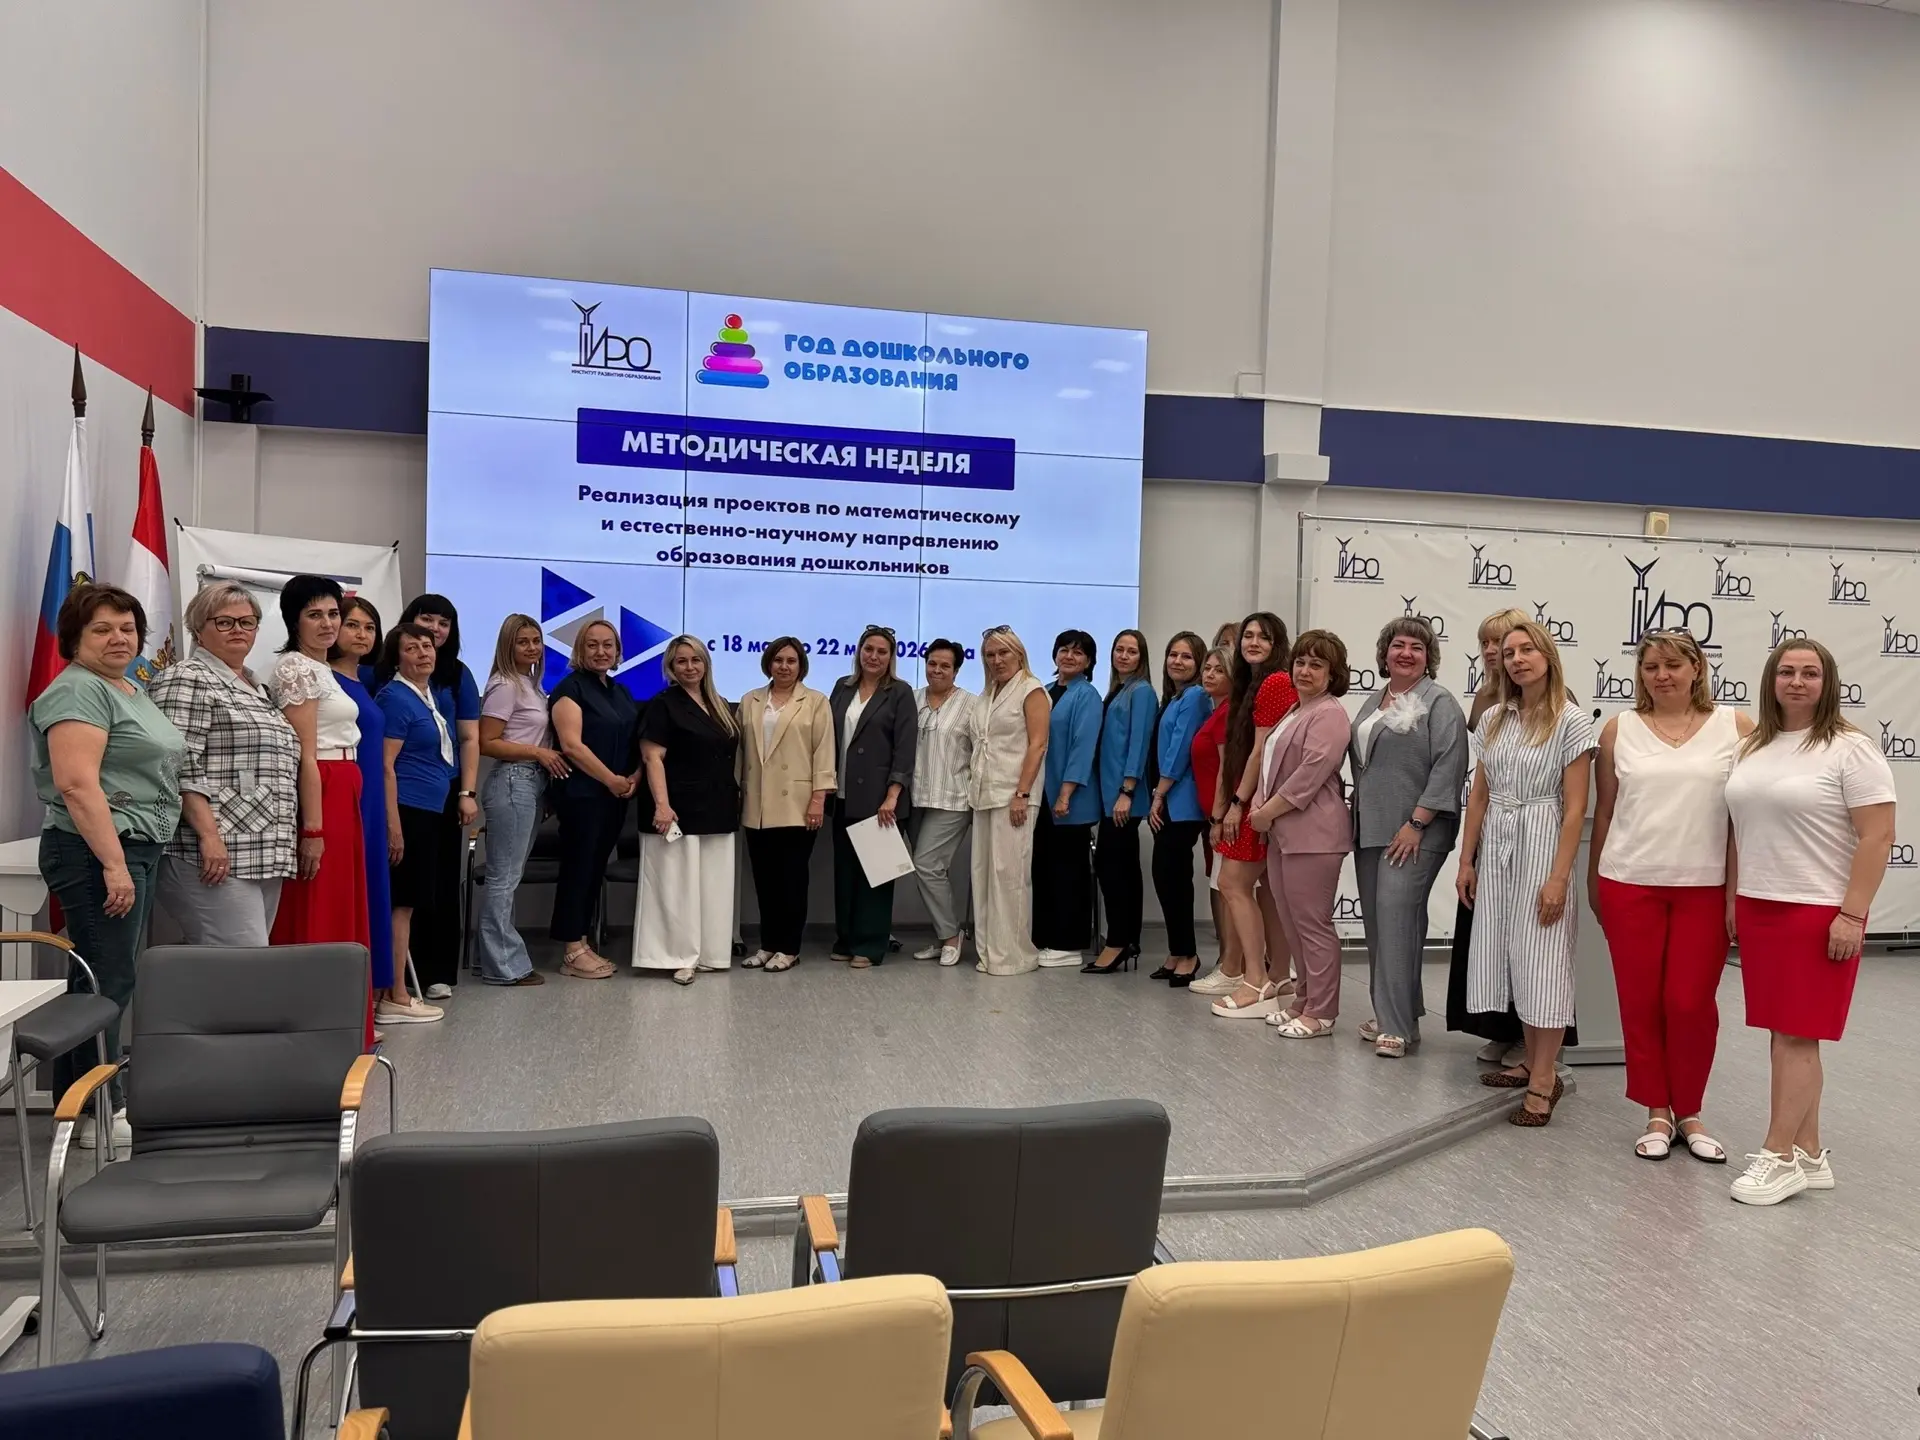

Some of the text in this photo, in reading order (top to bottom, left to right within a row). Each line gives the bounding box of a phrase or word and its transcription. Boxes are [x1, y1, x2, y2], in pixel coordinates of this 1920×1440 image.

[784, 333, 1030, 370] ГОД ДОШКОЛЬНОГО
[783, 362, 958, 392] ОБРАЗОВАНИЯ
[621, 430, 971, 475] МЕТОДИЧЕСКАЯ НЕДЕЛЯ
[578, 485, 1020, 530] Реализация проектов по математическому
[601, 520, 999, 551] и естественно-научному направлению
[656, 547, 950, 576] образования дошкольников
[707, 639, 716, 652] с
[723, 634, 743, 653] 18
[817, 638, 839, 655] 22
